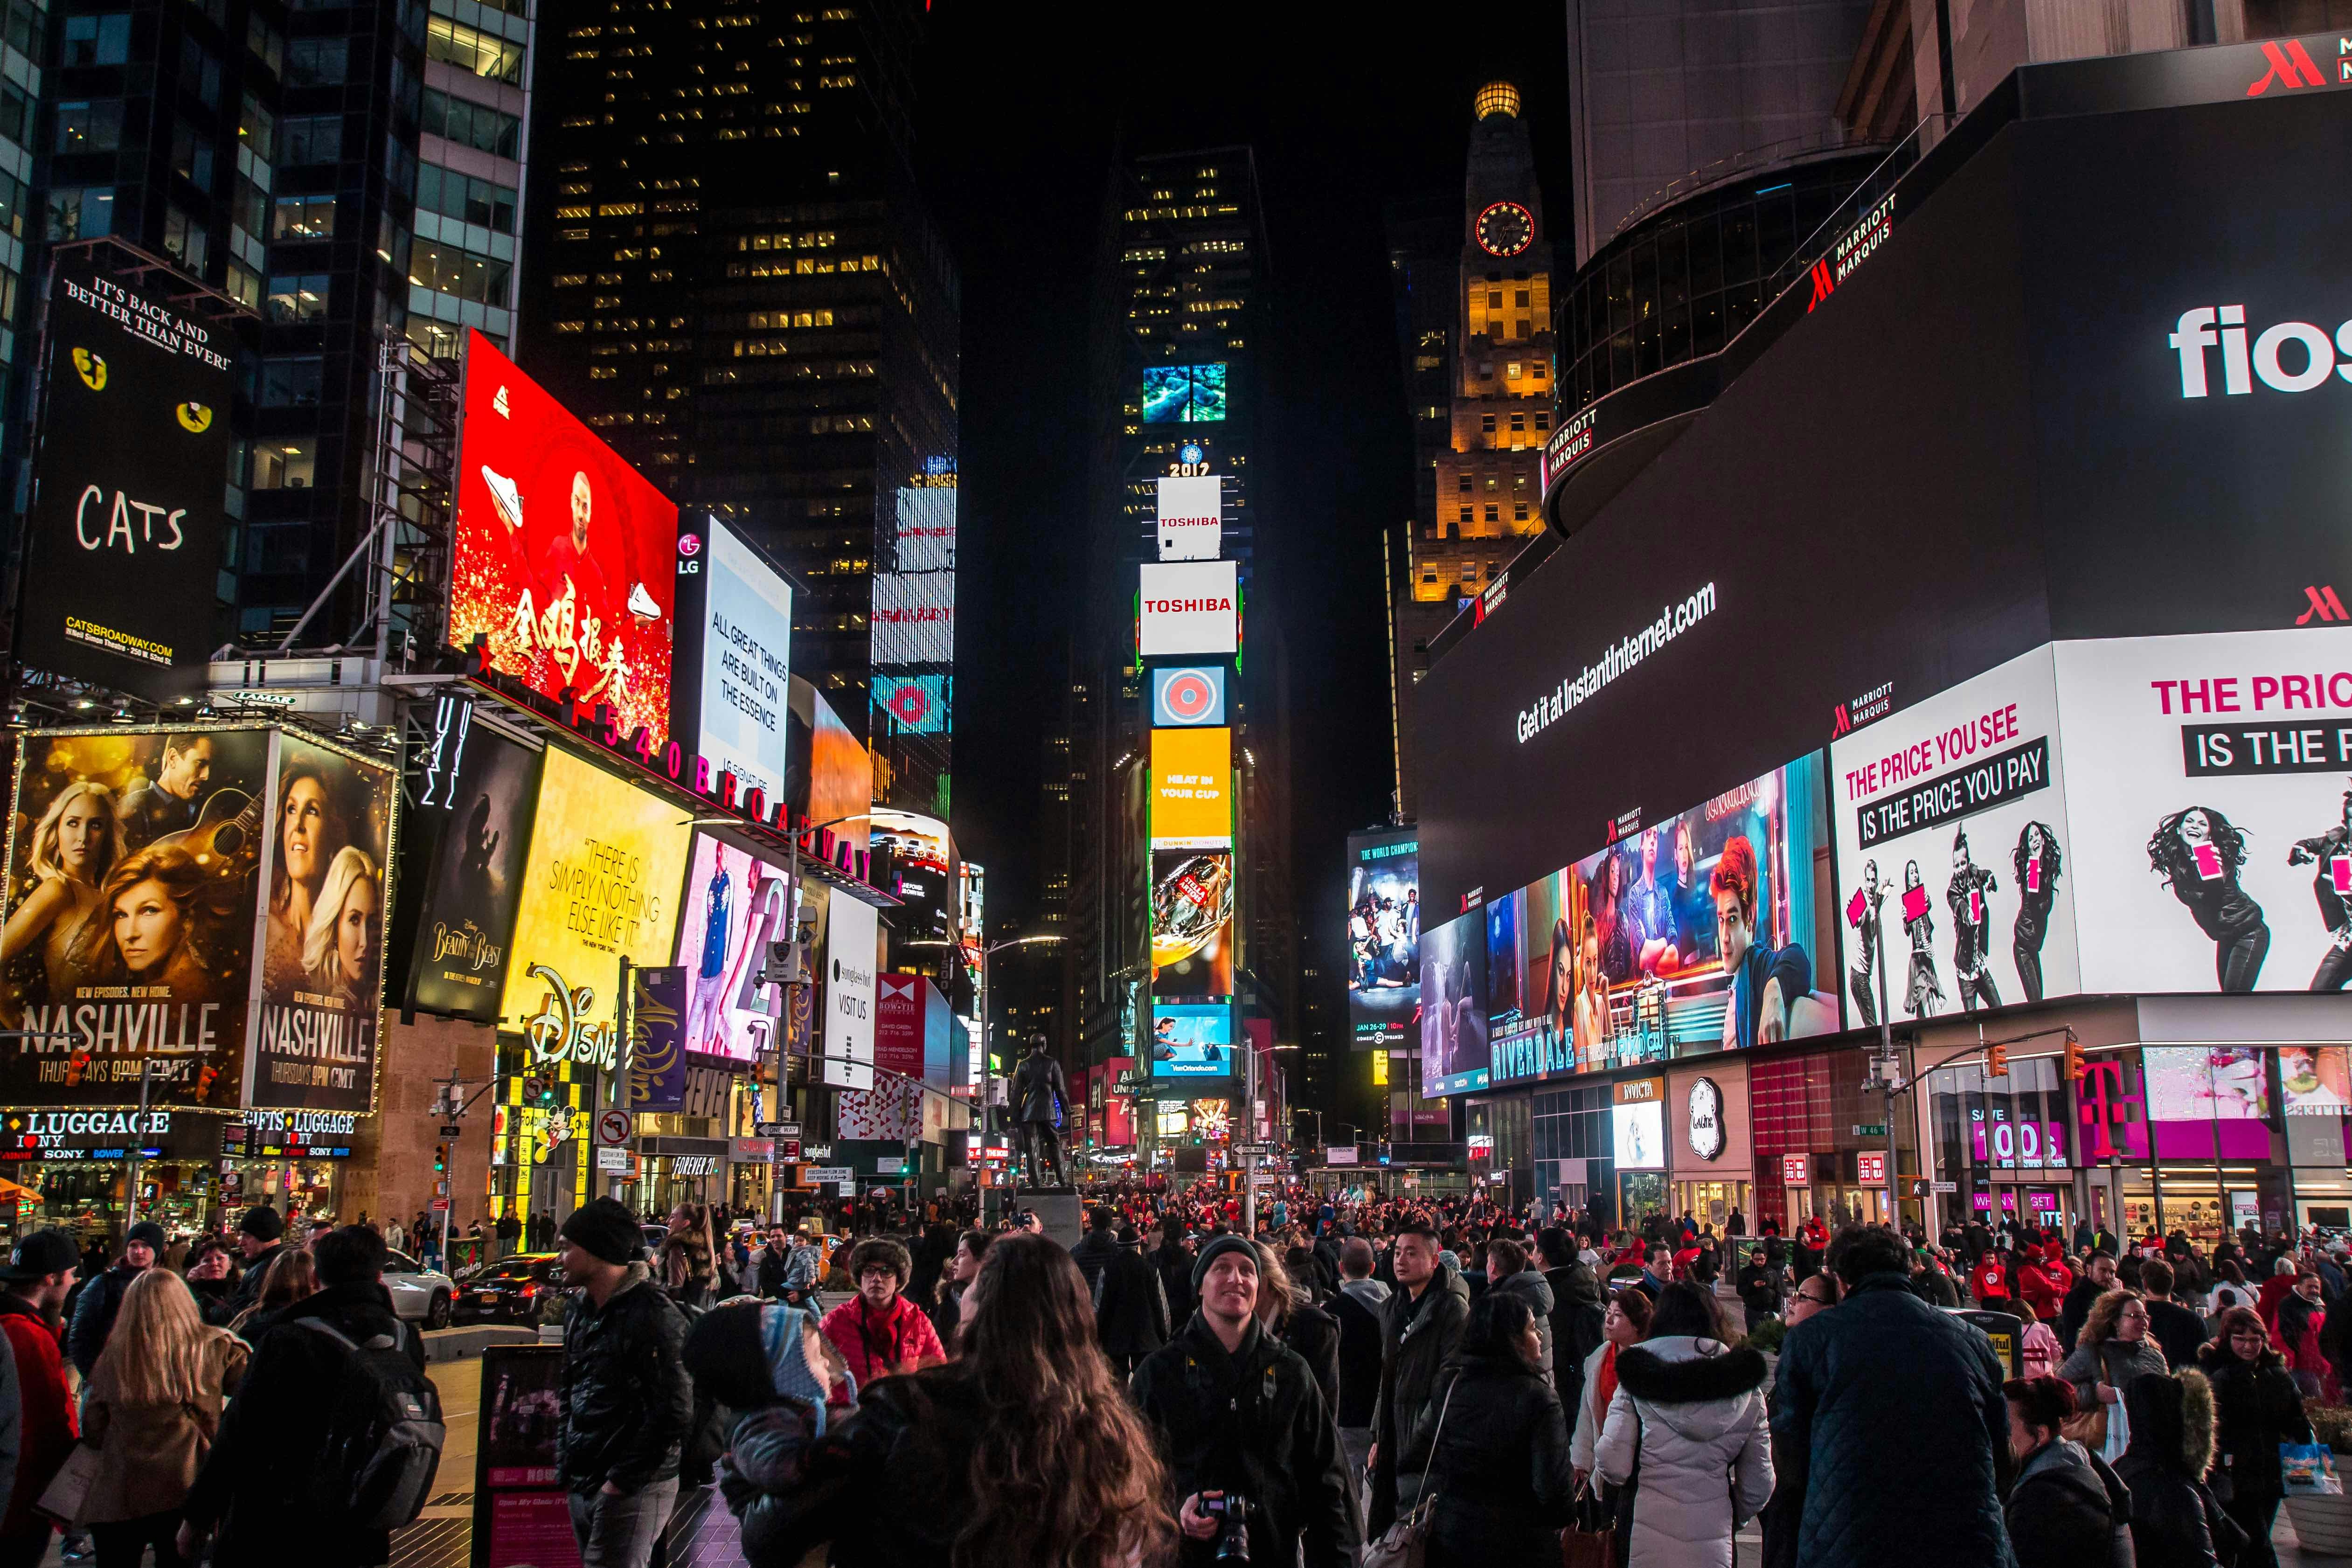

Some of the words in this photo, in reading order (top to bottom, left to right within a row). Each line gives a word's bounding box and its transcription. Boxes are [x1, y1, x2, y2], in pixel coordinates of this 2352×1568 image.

[1837, 193, 1895, 261] MARRIOTT
[1838, 222, 1890, 282] MARQUIS
[94, 276, 125, 303] IT'S
[129, 294, 172, 326] BACK
[175, 318, 208, 343] AND
[135, 314, 181, 348] THAN
[1550, 409, 1597, 458] MARRIOTT
[1550, 433, 1590, 478] MARQUIS
[1170, 463, 1209, 477] 2017
[77, 484, 187, 554] CATS
[1160, 516, 1218, 527] TOSHIBA
[679, 561, 699, 574] LG
[1485, 571, 1508, 602] MARRIOTT
[1145, 598, 1231, 613] TOSHIBA
[1485, 587, 1506, 615] MARQUIS
[66, 616, 173, 657] CATSBROADWAY.COM
[713, 612, 729, 639] ALL
[731, 625, 758, 660] GREAT
[760, 647, 787, 682] THINGS
[1517, 703, 1539, 743] Get
[1540, 696, 1549, 729] it
[1550, 686, 1563, 722] at
[1563, 582, 1716, 713] InstantInternet.com
[722, 650, 739, 677] ARE
[742, 663, 764, 694] BUILT
[765, 681, 778, 705] ON
[240, 692, 291, 705] LAMAR
[722, 679, 738, 707] THE
[740, 692, 776, 732] ESSENCE
[1852, 681, 1893, 710] MARRIOTT
[2151, 677, 2241, 715] THE
[2252, 672, 2352, 711] PRIC
[1853, 699, 1889, 724] MARQUIS
[1846, 763, 1878, 800] THE
[1881, 739, 1933, 788] PRICE
[1936, 720, 1976, 765] YOU
[1980, 702, 2019, 748] SEE
[2197, 733, 2234, 767] IS
[2243, 729, 2327, 765] THE
[571, 688, 681, 779] 1540
[696, 755, 871, 881] BROADWAY
[724, 757, 732, 772] LG
[734, 764, 767, 794] SIGNATURE
[1167, 775, 1198, 784] HEAT
[1201, 776, 1213, 785] IN
[1160, 788, 1193, 798] YOUR
[1195, 790, 1219, 799] CUP
[1862, 811, 1876, 841] IS
[1879, 797, 1910, 834] THE
[1913, 778, 1963, 823] PRICE
[1965, 763, 2001, 804] YOU
[2007, 747, 2041, 790] PAY
[1618, 807, 1641, 826] MARRIOTT
[1618, 820, 1639, 836] MARQUIS
[1361, 850, 1371, 860] THE
[1372, 846, 1389, 859] WORLD
[627, 855, 639, 883] IS
[549, 860, 597, 901] SIMPLY
[597, 878, 660, 922] NOTHING
[1179, 881, 1202, 903] ARTOIS
[1184, 877, 1205, 898] STELLA
[1468, 886, 1483, 899] MARRIOTT
[1468, 896, 1481, 908] MARQUIS
[568, 902, 597, 935] ELSE
[599, 911, 623, 943] LIKE
[471, 932, 502, 971] BEAST
[841, 966, 862, 987] sunglass
[76, 987, 93, 999] NEW
[131, 986, 148, 998] NEW
[840, 993, 856, 1015] VISIT
[858, 1000, 866, 1020] US
[20, 1003, 220, 1054] NASHVILLE
[261, 1004, 370, 1063] NASHVILLE
[1542, 1015, 1546, 1026] IT
[1492, 1027, 1575, 1081] RIVERDALE
[1587, 1041, 1609, 1062] THURSDAY
[111, 1060, 142, 1082] 9PM
[148, 1059, 194, 1082] CMT
[271, 1061, 312, 1085] THURSDAYS
[312, 1065, 329, 1086] 9PM
[331, 1067, 355, 1089] CMT
[1623, 1079, 1653, 1100] INVICTA
[294, 1112, 355, 1134] LUGGAGE
[37, 1135, 64, 1148] NY
[298, 1132, 312, 1144] NY
[44, 1150, 84, 1159] SONY
[93, 1149, 125, 1158] BOWER
[310, 1148, 331, 1156] SONY
[805, 1144, 824, 1161] sunglass
[675, 1157, 706, 1175] FOREVER
[705, 1157, 715, 1175] 21
[2031, 1197, 2050, 1206] GET
